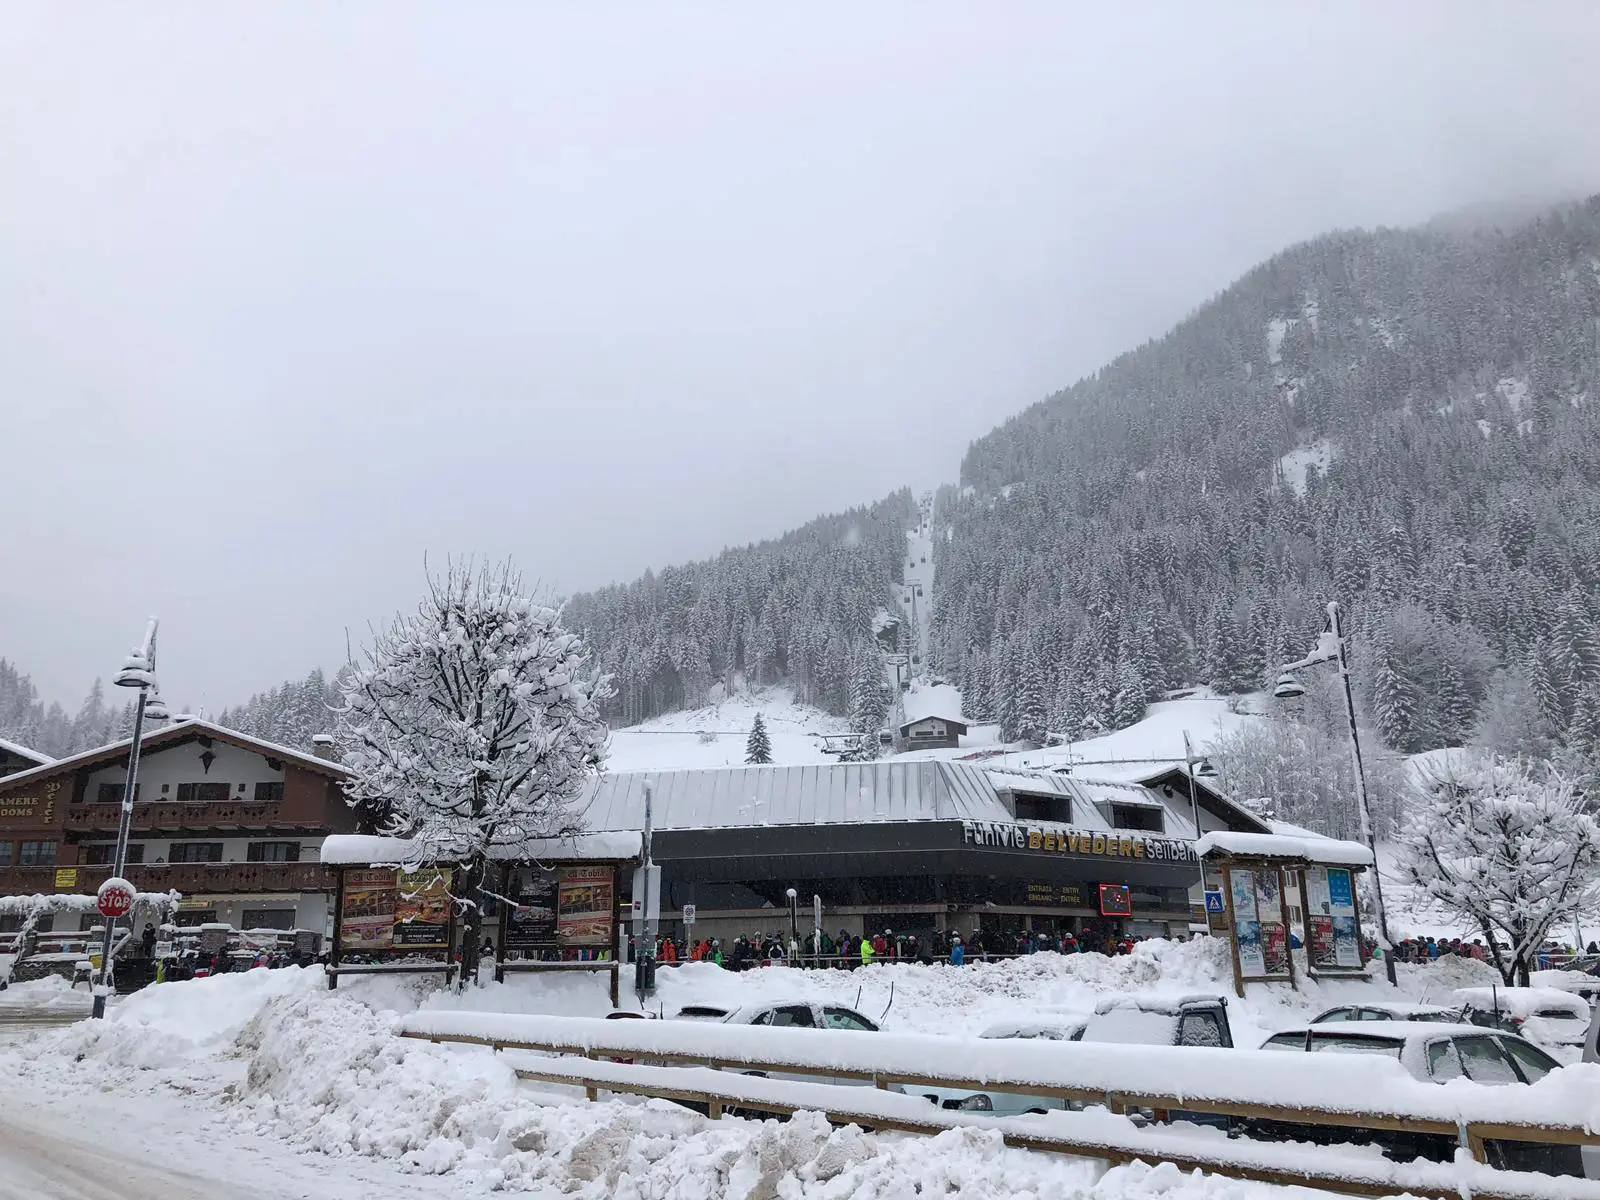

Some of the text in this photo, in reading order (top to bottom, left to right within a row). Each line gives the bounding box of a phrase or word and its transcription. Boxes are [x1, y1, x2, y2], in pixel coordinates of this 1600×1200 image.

[963, 822, 1025, 849] Funivie
[1028, 831, 1145, 858] BELVEDERE
[1062, 886, 1080, 894] ENTRY
[100, 895, 131, 908] STOP
